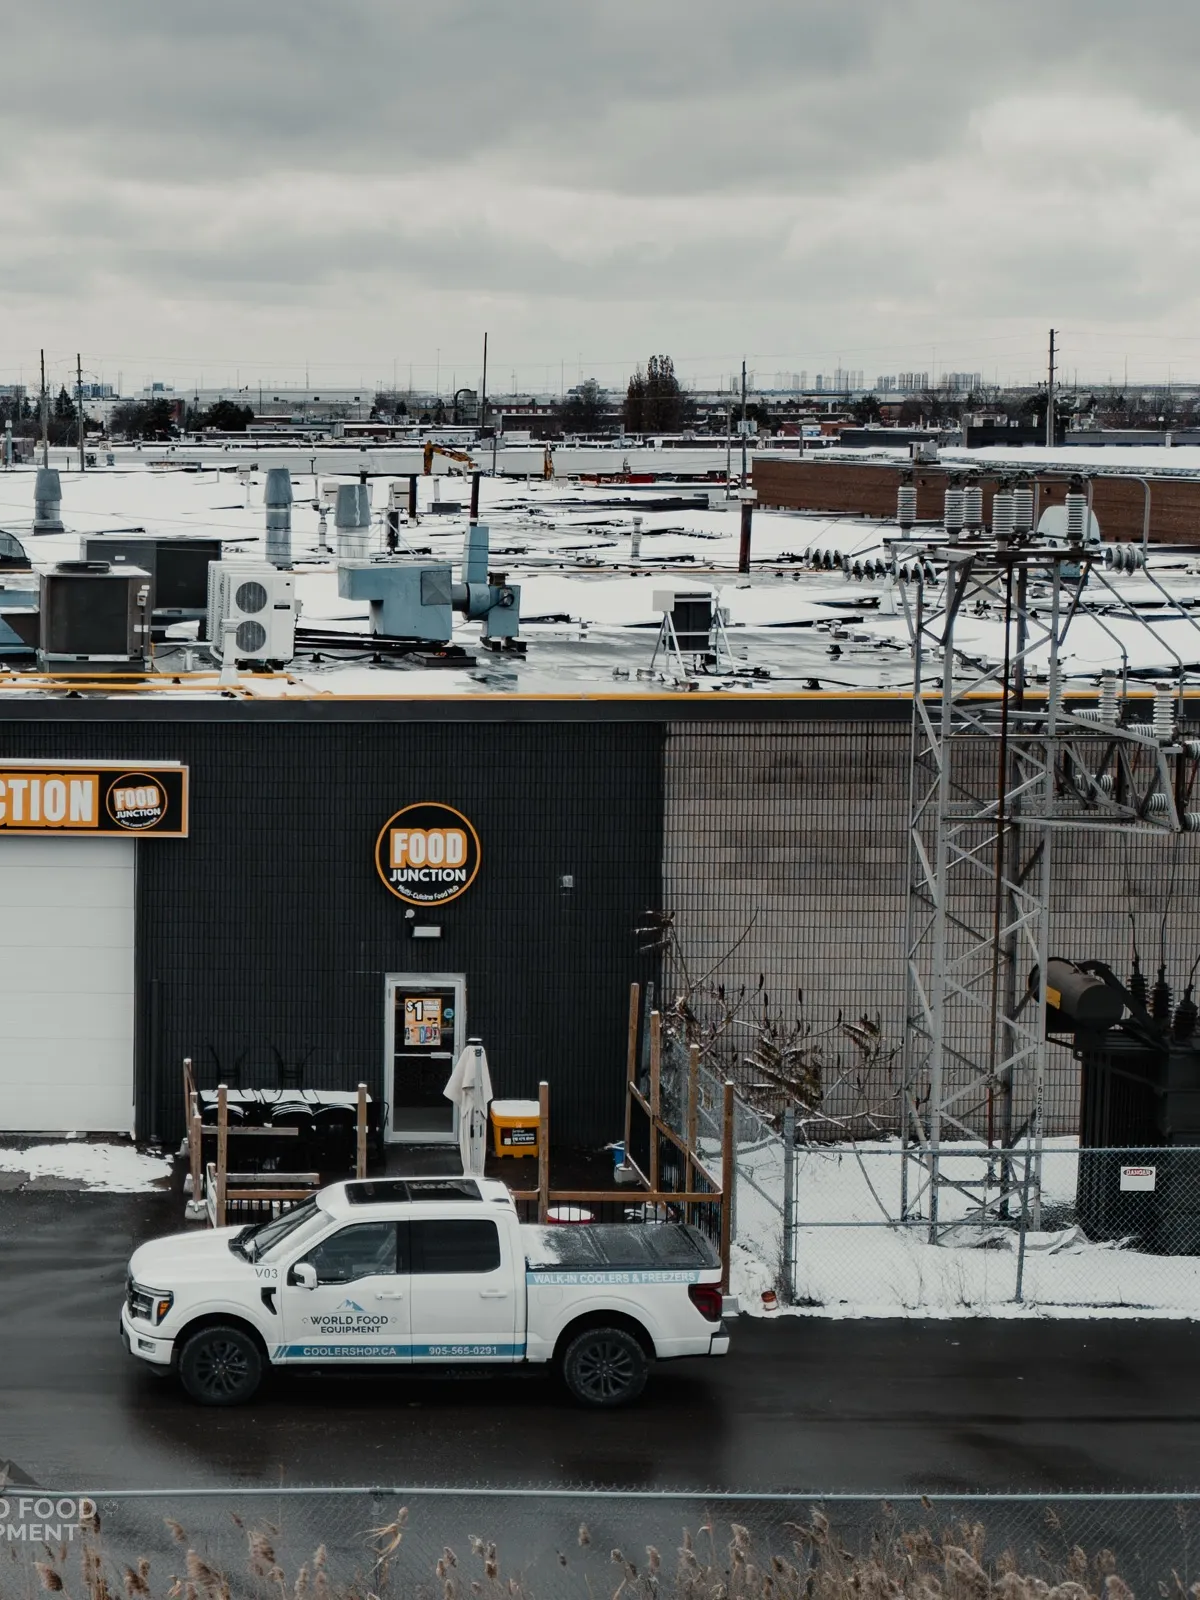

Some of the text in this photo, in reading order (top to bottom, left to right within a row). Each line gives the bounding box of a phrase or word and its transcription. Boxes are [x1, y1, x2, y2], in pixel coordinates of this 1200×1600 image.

[115, 787, 158, 810] FOOD
[116, 808, 161, 819] JUNCTION
[392, 830, 464, 866] FOOD
[390, 868, 466, 881] JUNCTION
[434, 890, 448, 900] Food
[405, 1000, 424, 1022] $1
[255, 1268, 278, 1279] V03
[533, 1271, 696, 1284] WALK-IN COOLERS & FREEZERS
[310, 1315, 388, 1325] WORLD FOOD
[320, 1325, 381, 1334] EQUIPMENT
[303, 1347, 397, 1356] COOLERSHOP.CA
[428, 1346, 497, 1355] 905-565-0291
